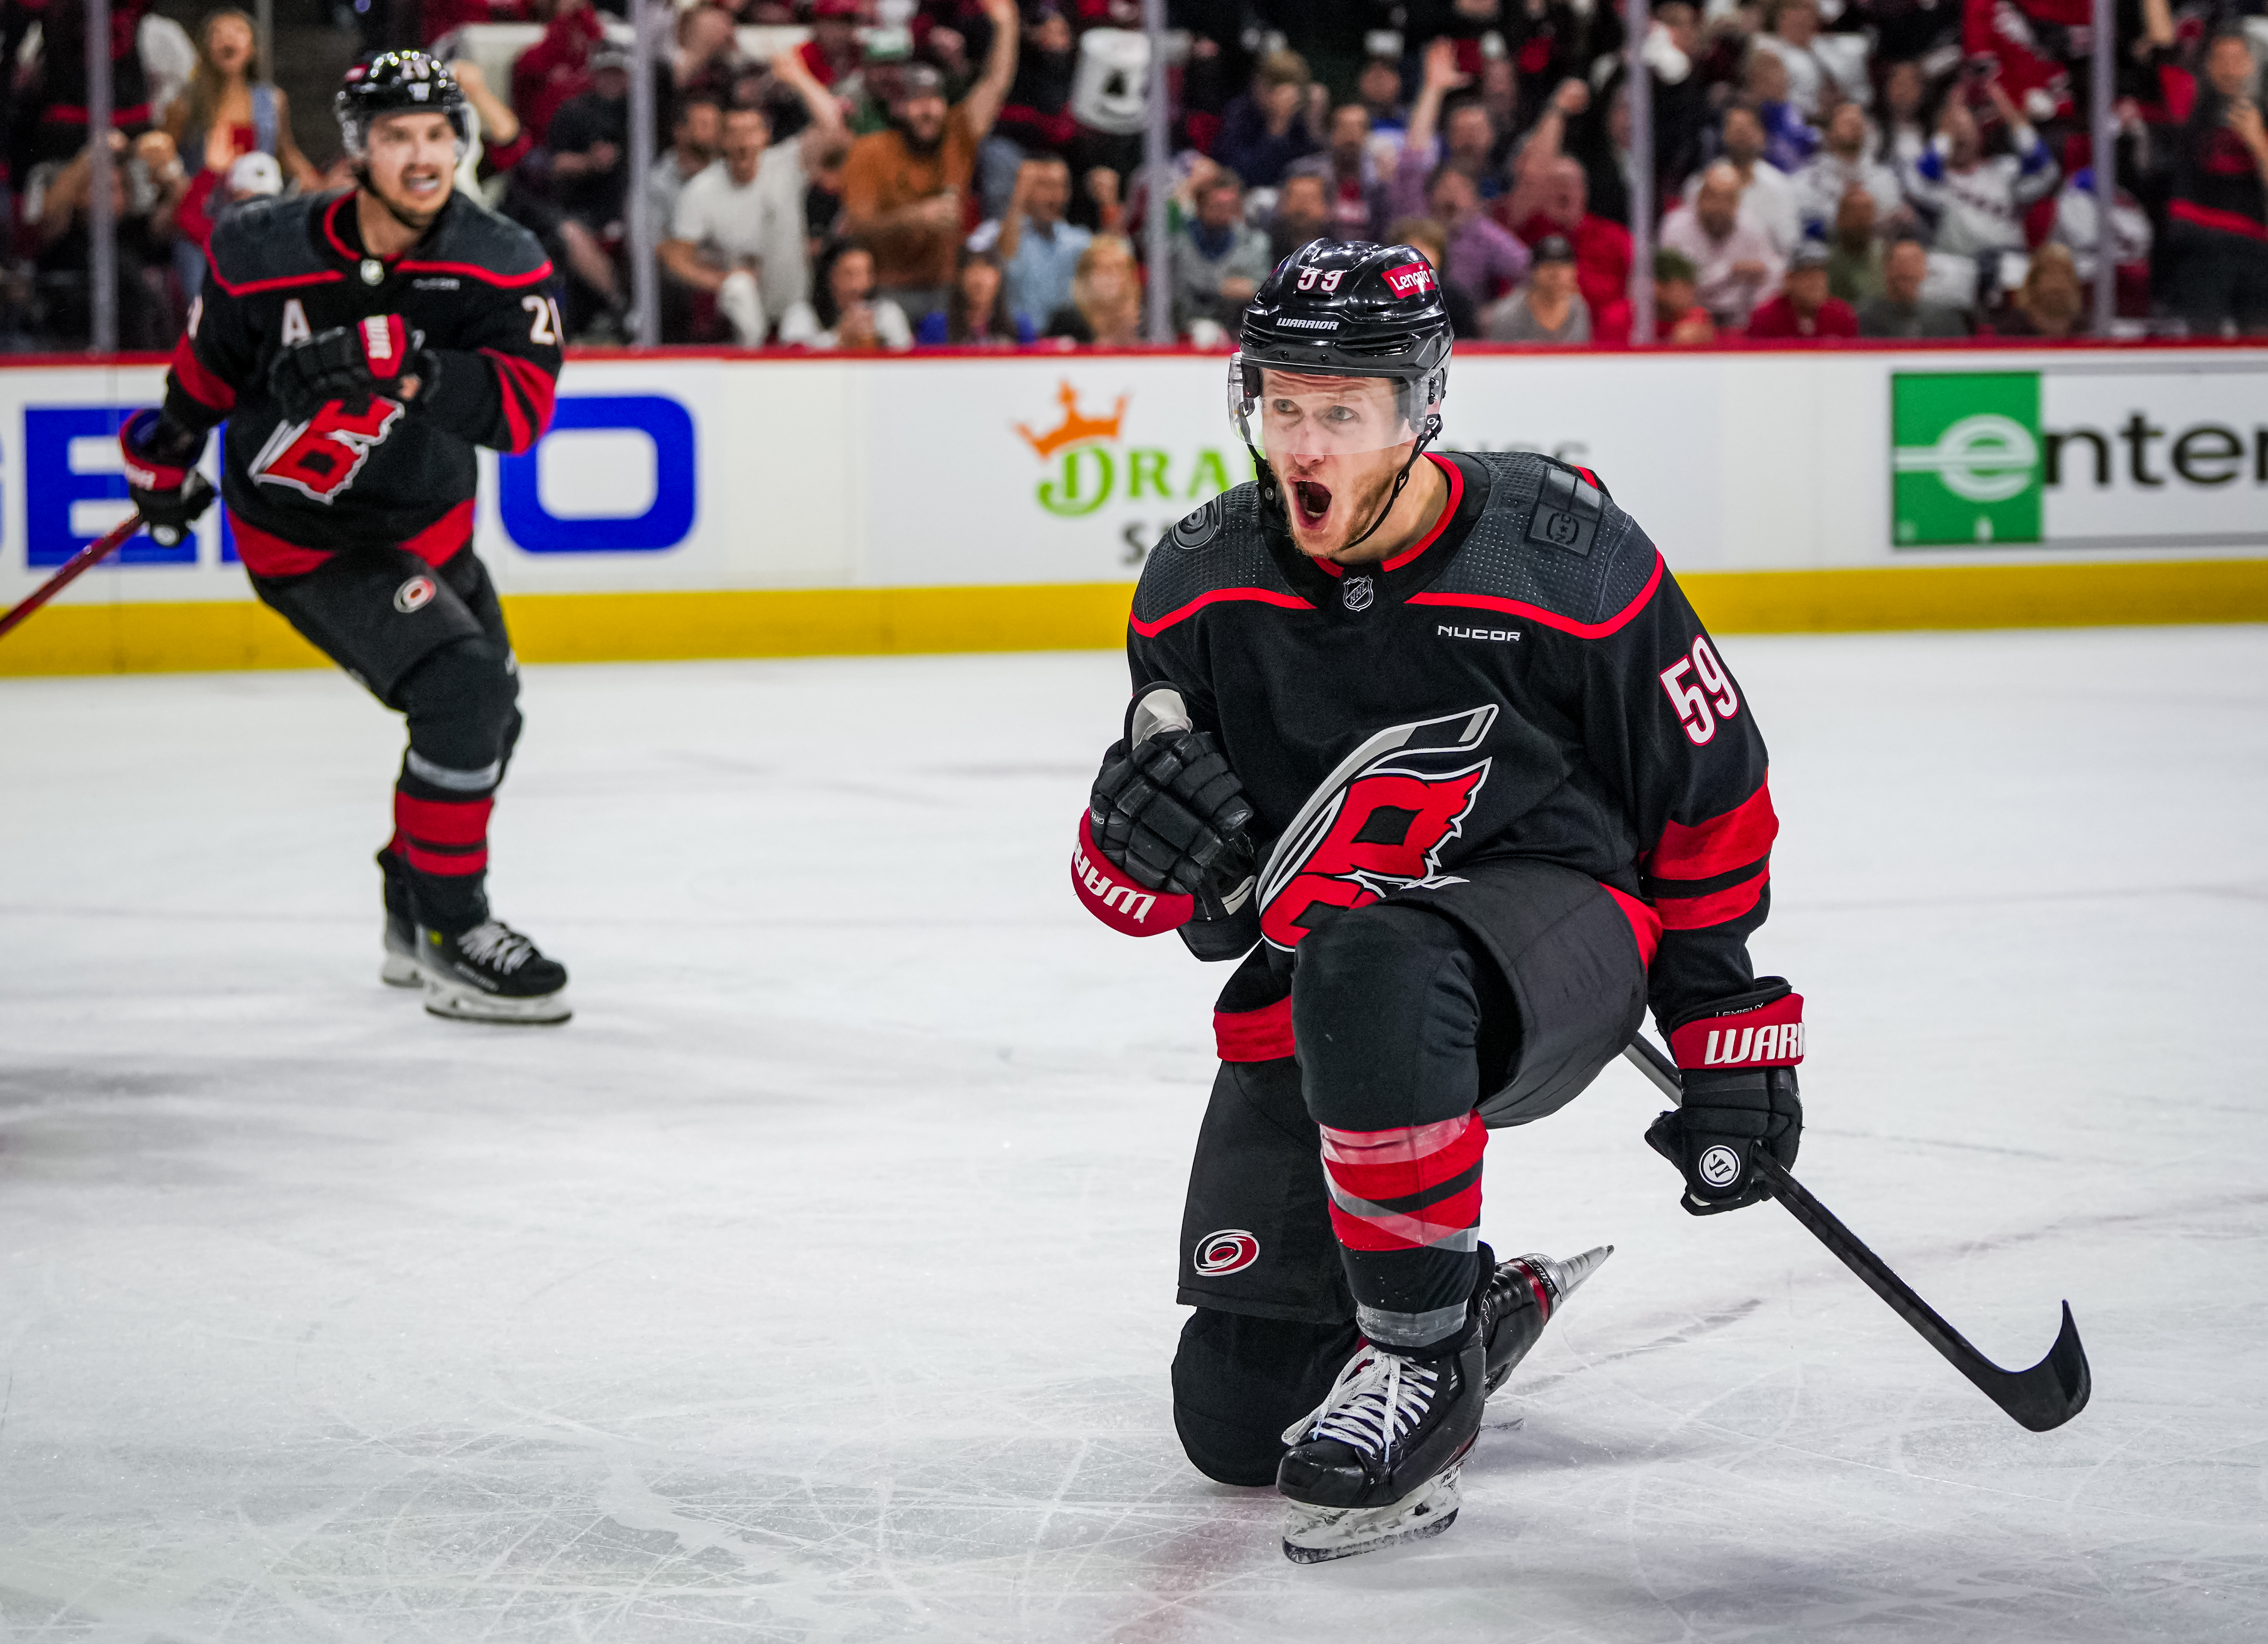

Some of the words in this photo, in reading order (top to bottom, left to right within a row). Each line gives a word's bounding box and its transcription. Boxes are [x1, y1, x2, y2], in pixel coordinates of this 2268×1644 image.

[1297, 268, 1346, 292] 59
[1389, 270, 1430, 291] Lenovo
[281, 297, 311, 346] A
[1276, 318, 1340, 330] WARRIOR
[1350, 583, 1367, 604] NHL
[1437, 625, 1520, 642] NUCOR
[1659, 634, 1739, 746] 59
